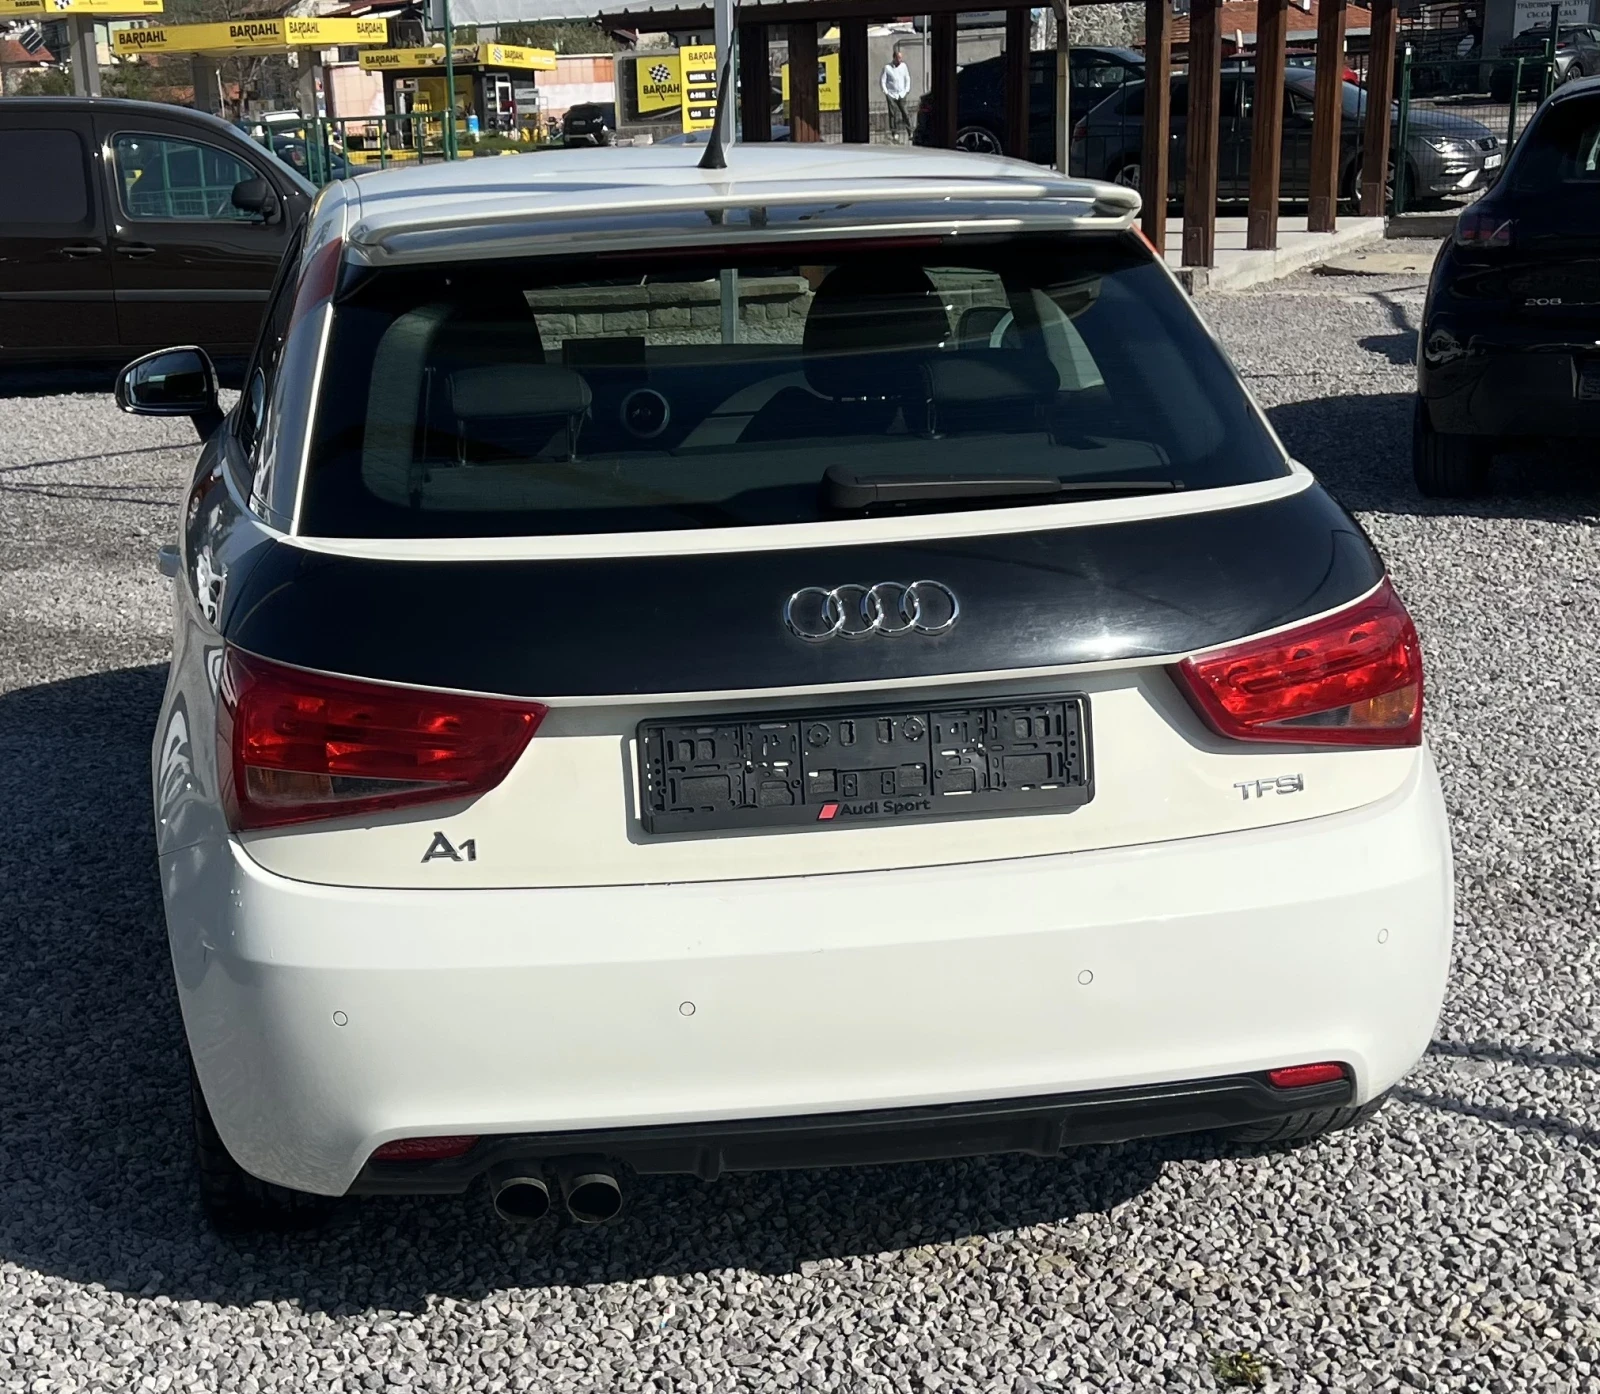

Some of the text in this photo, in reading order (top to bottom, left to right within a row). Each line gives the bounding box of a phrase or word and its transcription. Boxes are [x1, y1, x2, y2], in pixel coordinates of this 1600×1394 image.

[119, 23, 280, 48] BARDAHL BARDAHL
[289, 21, 385, 39] BARDAHL BARDAHL
[365, 54, 400, 66] BARDAHL
[504, 49, 524, 63] BARDAHL
[688, 52, 716, 64] BARDA
[643, 84, 680, 101] BARDAH
[1525, 298, 1562, 306] 208
[1233, 773, 1304, 800] TFSI
[840, 800, 931, 816] Audi Sport
[420, 831, 477, 863] A1
